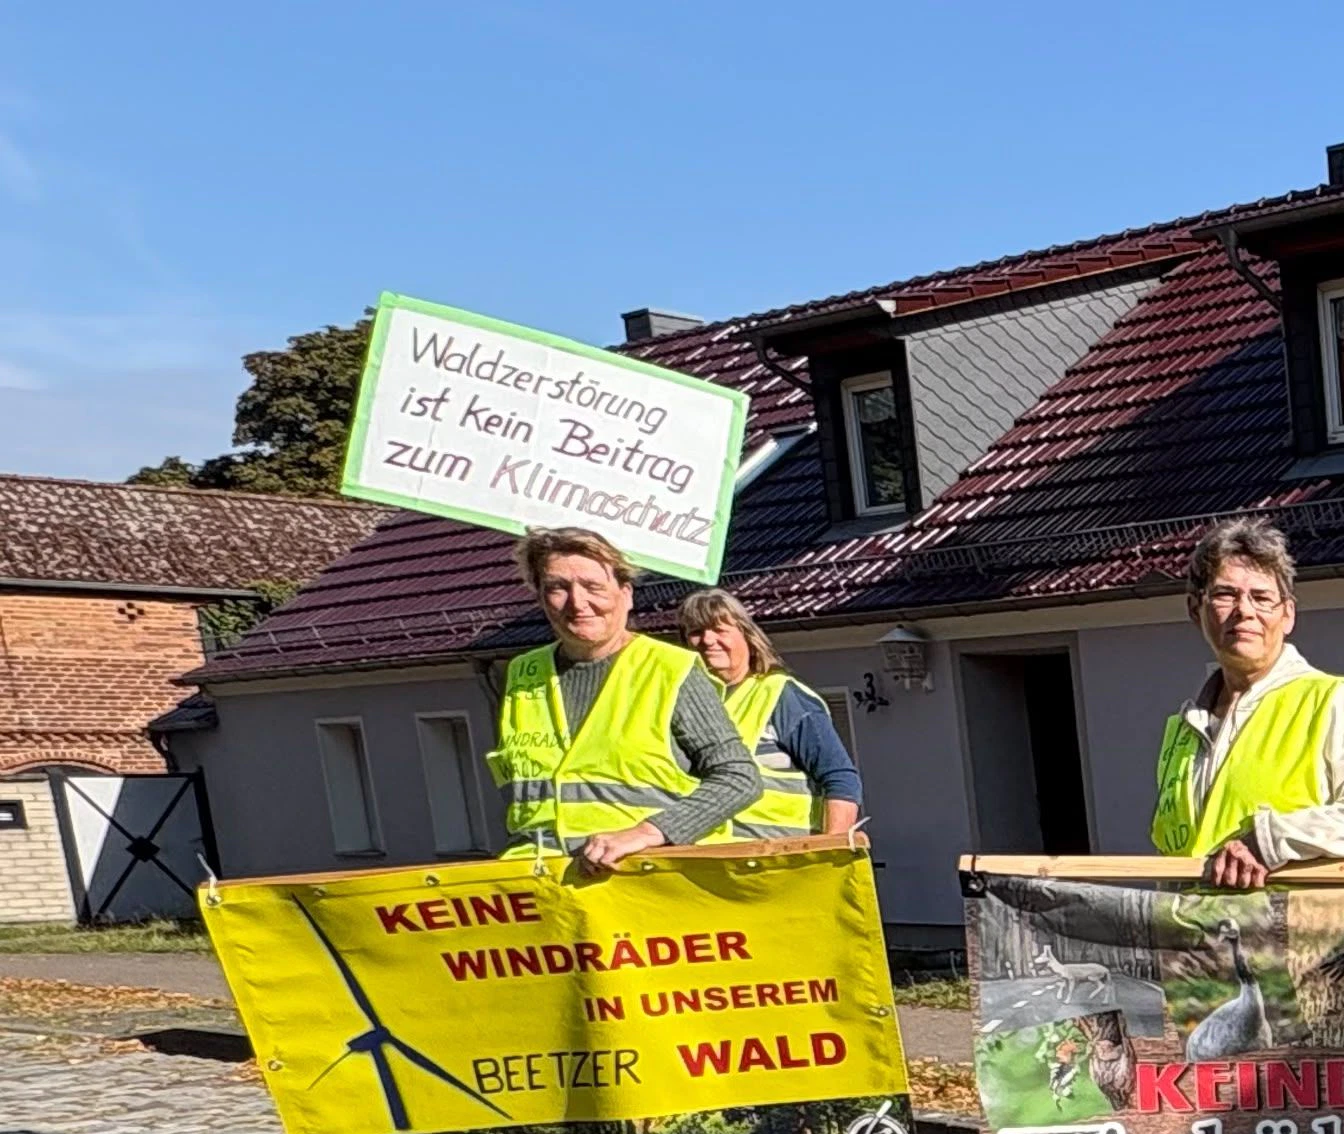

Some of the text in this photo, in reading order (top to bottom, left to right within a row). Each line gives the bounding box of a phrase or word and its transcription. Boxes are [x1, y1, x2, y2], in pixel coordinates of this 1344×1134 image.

[411, 326, 668, 434] Waldzerstörung
[400, 387, 450, 422] ist
[552, 418, 694, 494] Beitrag
[384, 441, 715, 546] zum Klimaschutz
[375, 891, 541, 934] KEINE
[441, 930, 752, 982] WINDRÄDER
[584, 978, 839, 1022] IN UNSEREM
[472, 1032, 848, 1095] BEETZER WALD
